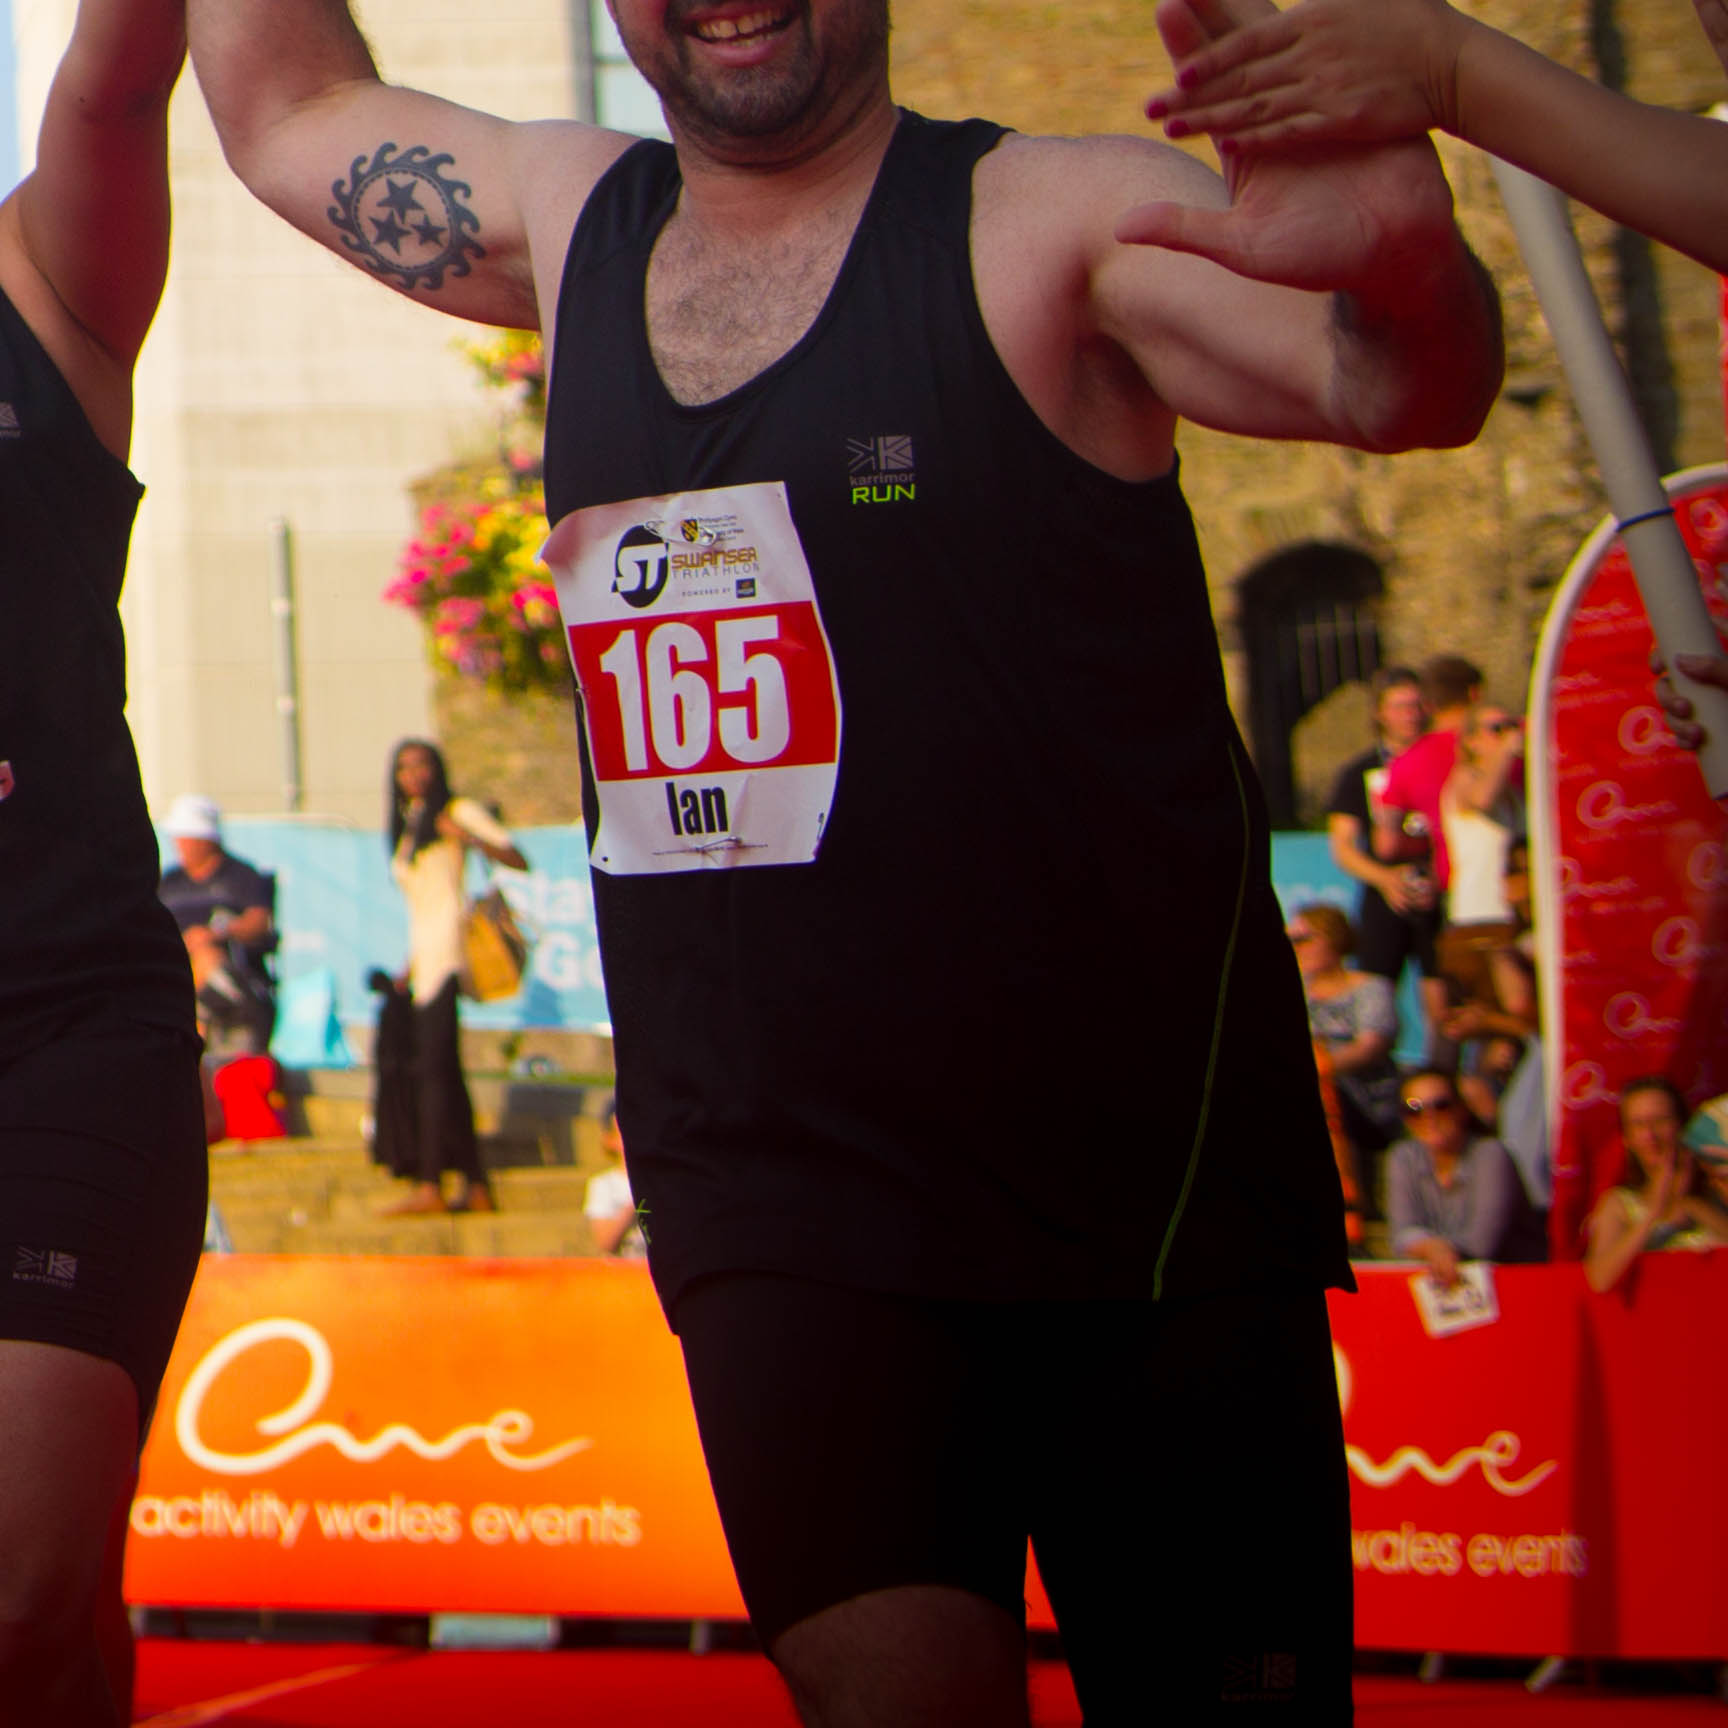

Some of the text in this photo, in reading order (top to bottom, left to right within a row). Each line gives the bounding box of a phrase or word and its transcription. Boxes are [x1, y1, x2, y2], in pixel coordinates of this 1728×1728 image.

[849, 473, 913, 486] karrimor
[852, 483, 916, 504] RUN
[672, 547, 757, 569] SWANSEA
[672, 562, 760, 579] TRIATHLON
[599, 615, 791, 772] 165
[665, 782, 729, 835] Ian
[129, 1491, 641, 1547] activity wales events
[1467, 1528, 1589, 1578] events
